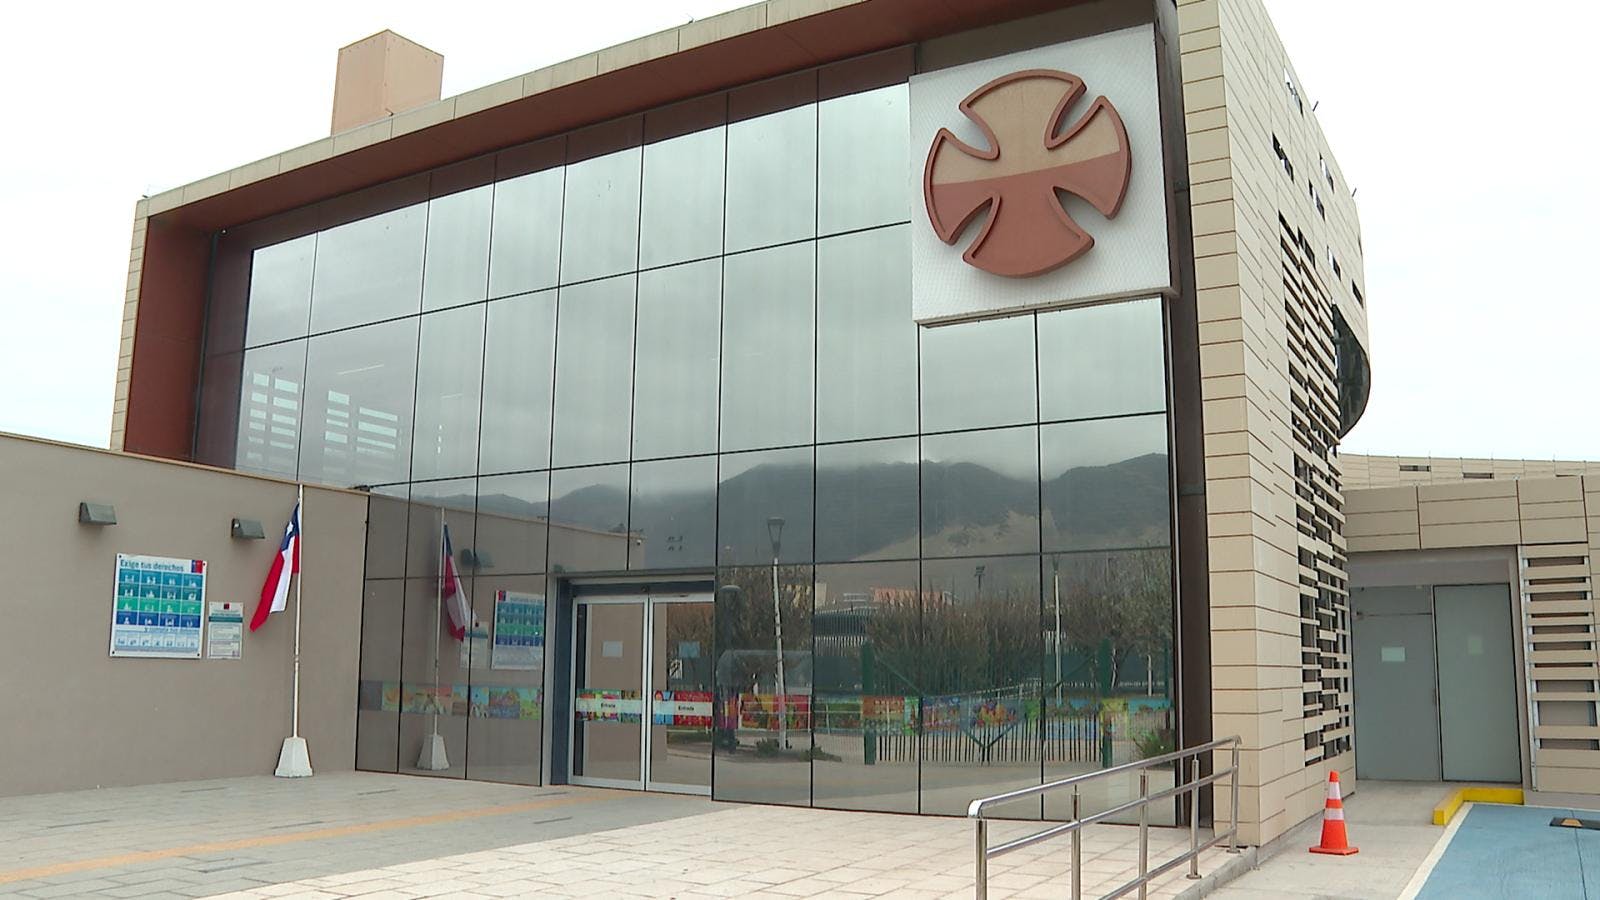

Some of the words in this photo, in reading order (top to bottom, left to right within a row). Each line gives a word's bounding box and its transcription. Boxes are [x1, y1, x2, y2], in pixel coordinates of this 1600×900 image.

[120, 559, 140, 569] Exige
[141, 561, 152, 569] tus
[153, 562, 184, 572] derechos
